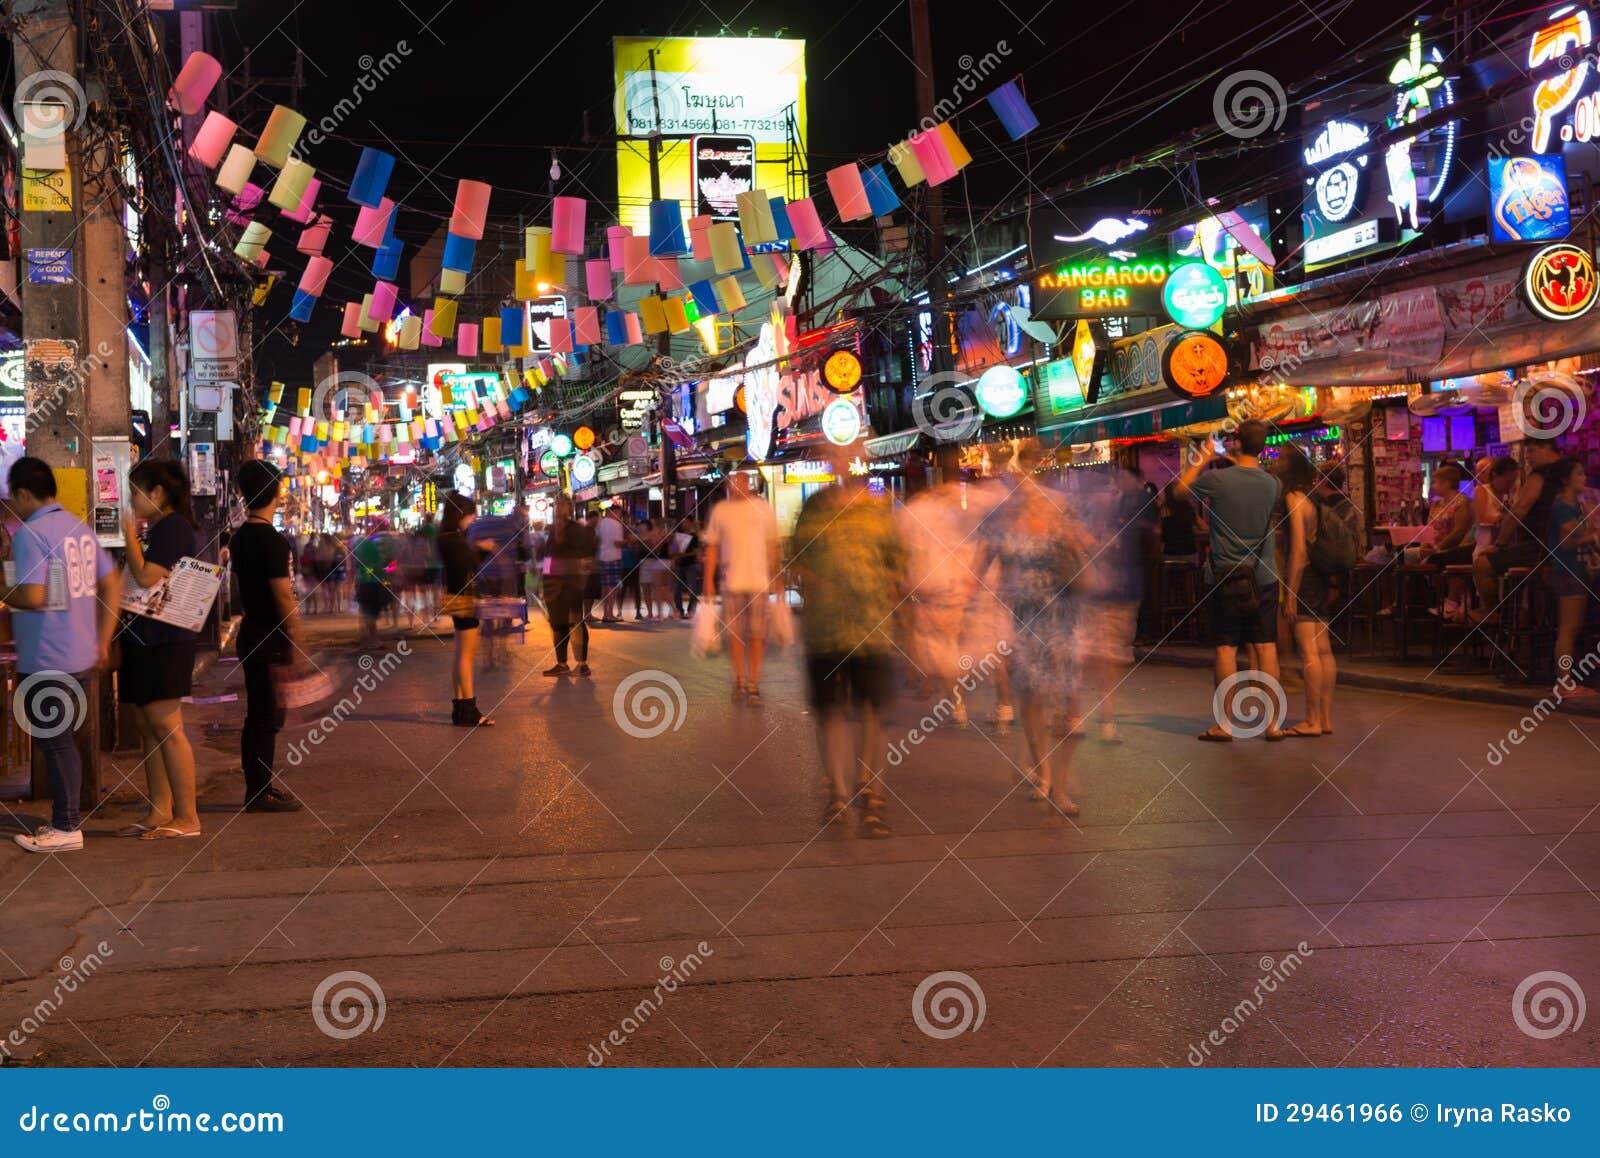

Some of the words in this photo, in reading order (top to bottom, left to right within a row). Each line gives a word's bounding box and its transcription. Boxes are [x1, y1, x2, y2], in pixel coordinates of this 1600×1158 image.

[682, 86, 744, 108] โฆษณา
[1505, 186, 1564, 224] Tiger
[1081, 288, 1129, 308] BAR
[190, 561, 212, 574] Show
